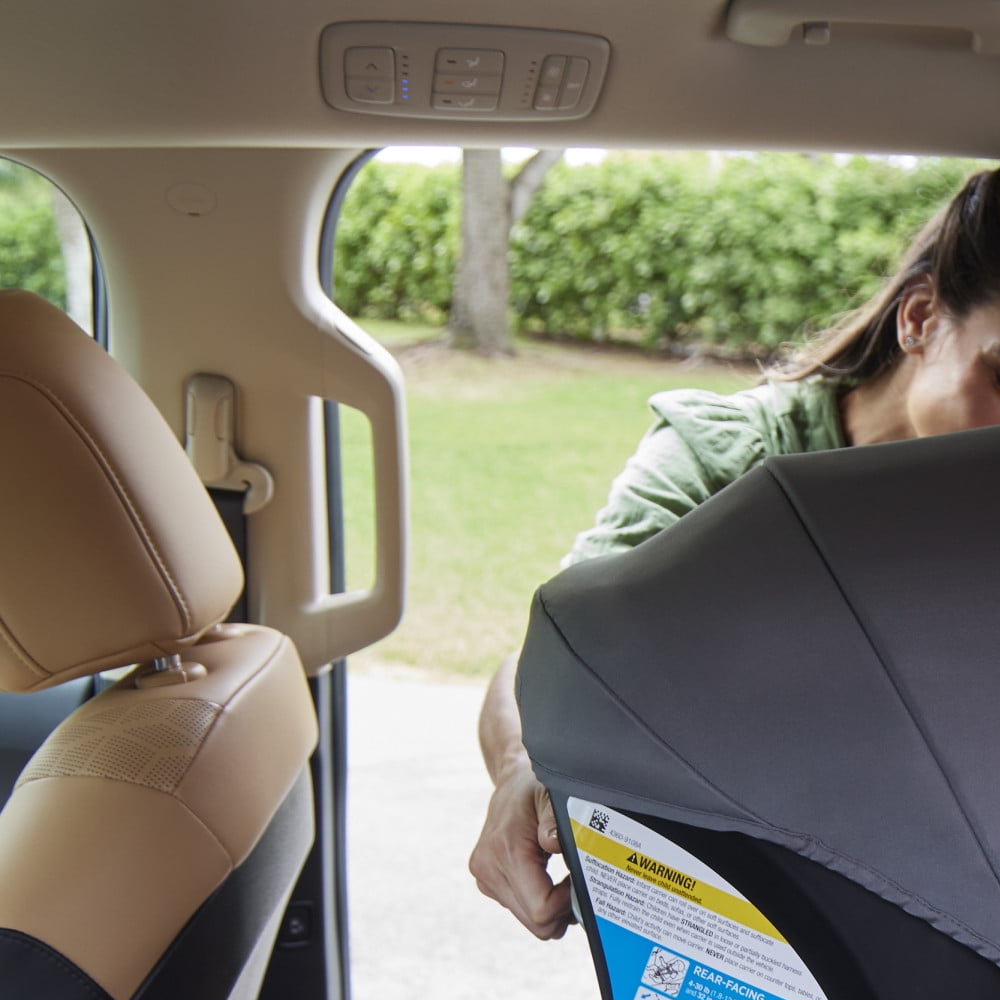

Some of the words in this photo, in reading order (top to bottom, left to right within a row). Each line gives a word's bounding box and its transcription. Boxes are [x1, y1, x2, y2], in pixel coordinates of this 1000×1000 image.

[584, 855, 615, 873] Suffocation
[615, 869, 635, 882] Hazard:
[625, 865, 641, 876] Never
[642, 872, 657, 882] leave
[657, 879, 671, 889] child
[637, 856, 696, 890] WARNING!
[588, 876, 624, 896] Strangulation
[625, 892, 645, 905] Hazard:
[680, 917, 714, 936] STRANGLED
[594, 897, 605, 906] Fall
[605, 902, 626, 915] Hazard:
[705, 947, 724, 959] NEVER
[687, 979, 703, 990] 4-30
[696, 992, 706, 1000] 32
